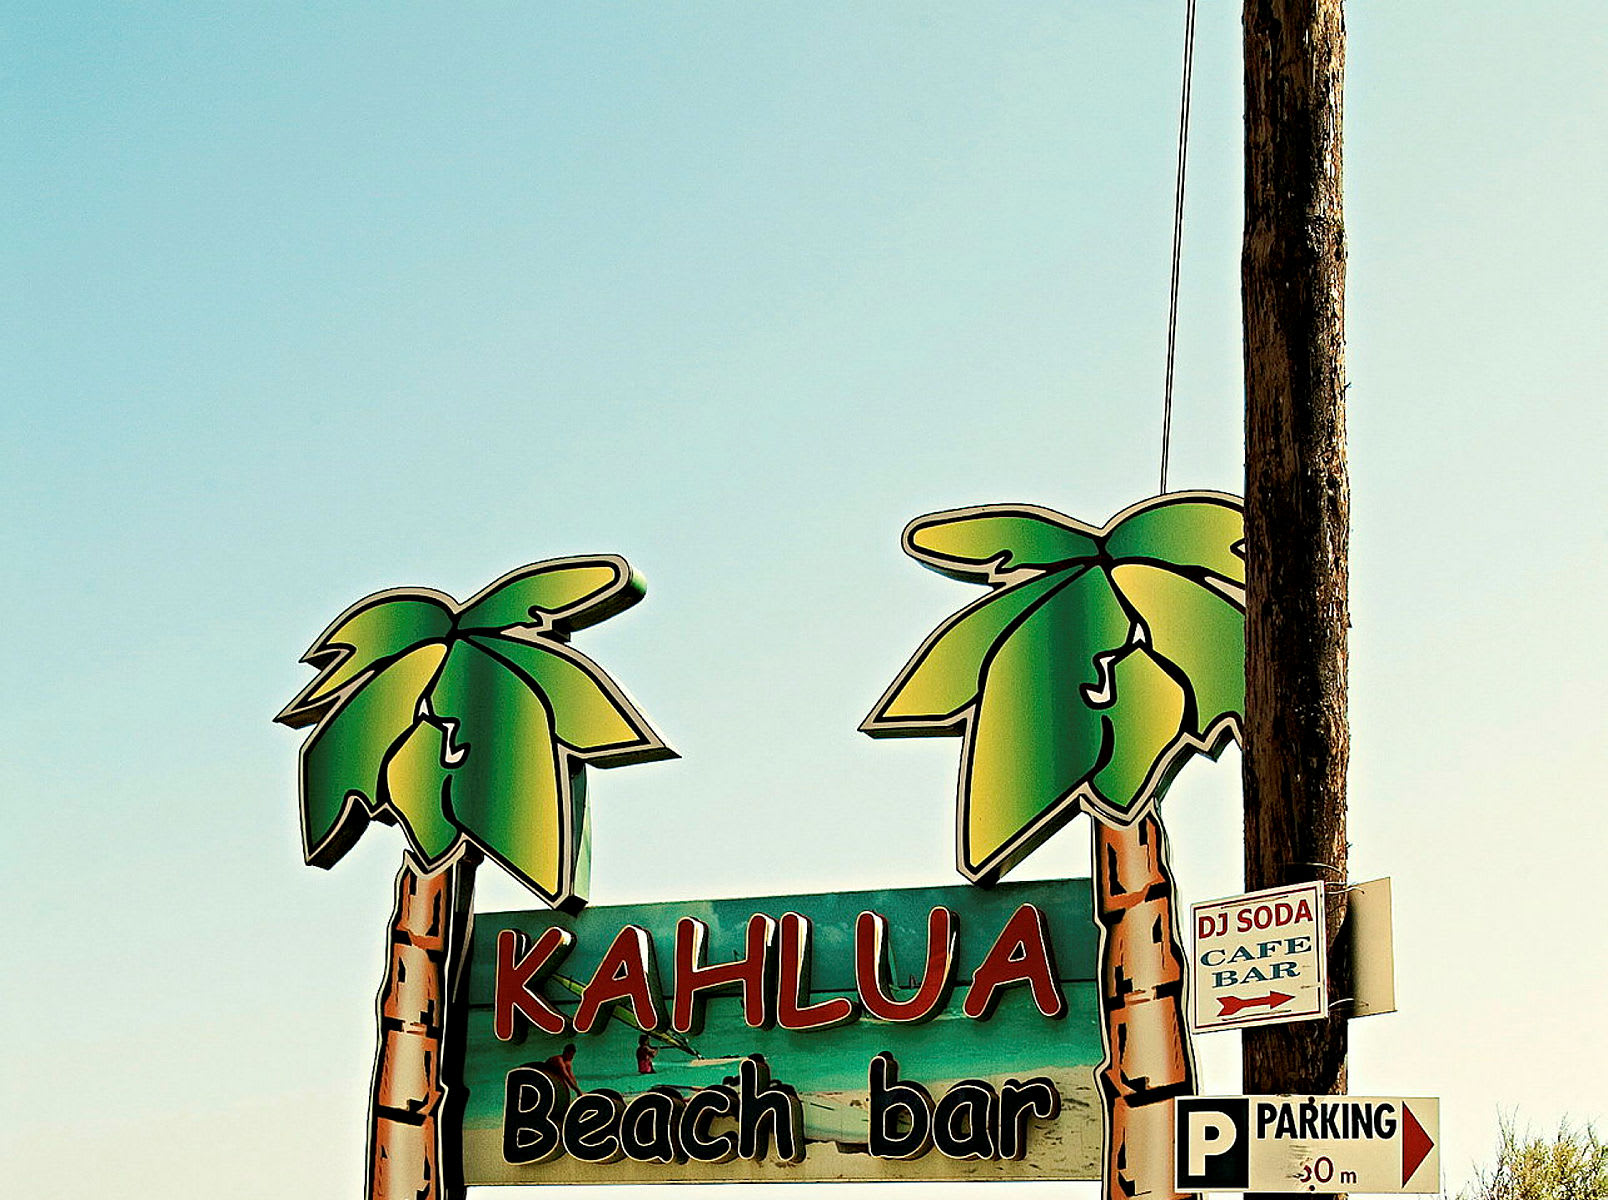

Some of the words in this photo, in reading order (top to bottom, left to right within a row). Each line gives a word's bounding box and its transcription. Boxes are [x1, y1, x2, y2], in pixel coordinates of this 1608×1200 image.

[1198, 912, 1228, 939] DJ
[1237, 899, 1313, 931] SODA
[1200, 935, 1312, 967] CAFE
[494, 903, 1066, 1041] KAHLUA
[1212, 961, 1301, 988] BAR
[502, 1053, 803, 1165] Beach
[868, 1051, 1060, 1162] bar
[1188, 1110, 1237, 1176] P
[1256, 1102, 1397, 1140] PARKING
[1341, 1171, 1357, 1184] m
